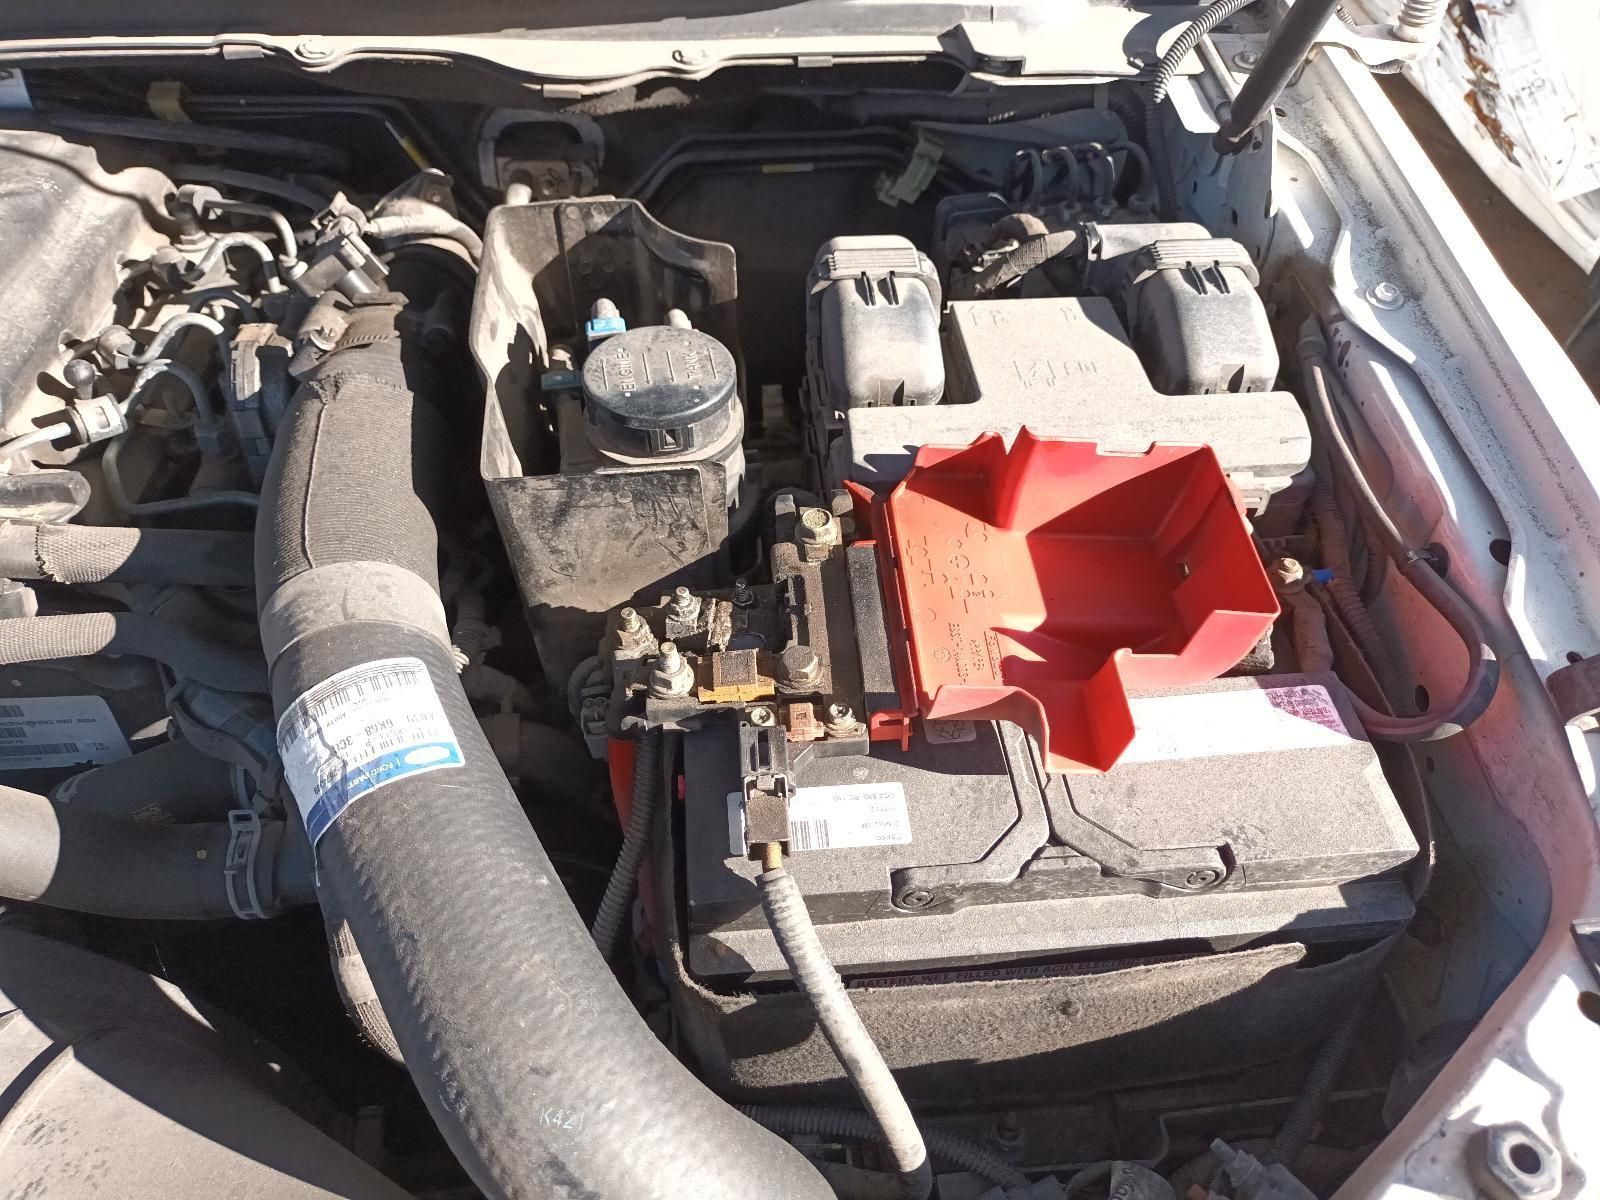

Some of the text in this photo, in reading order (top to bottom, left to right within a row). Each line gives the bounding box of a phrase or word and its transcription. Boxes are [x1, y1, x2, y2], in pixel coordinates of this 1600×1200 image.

[616, 352, 636, 392] ENGINE
[682, 350, 702, 380] TANK
[370, 760, 394, 777] FORD
[957, 969, 1001, 980] FILLED
[1006, 967, 1038, 977] WITH
[1044, 964, 1073, 973] ACID
[539, 1107, 585, 1130] K421
